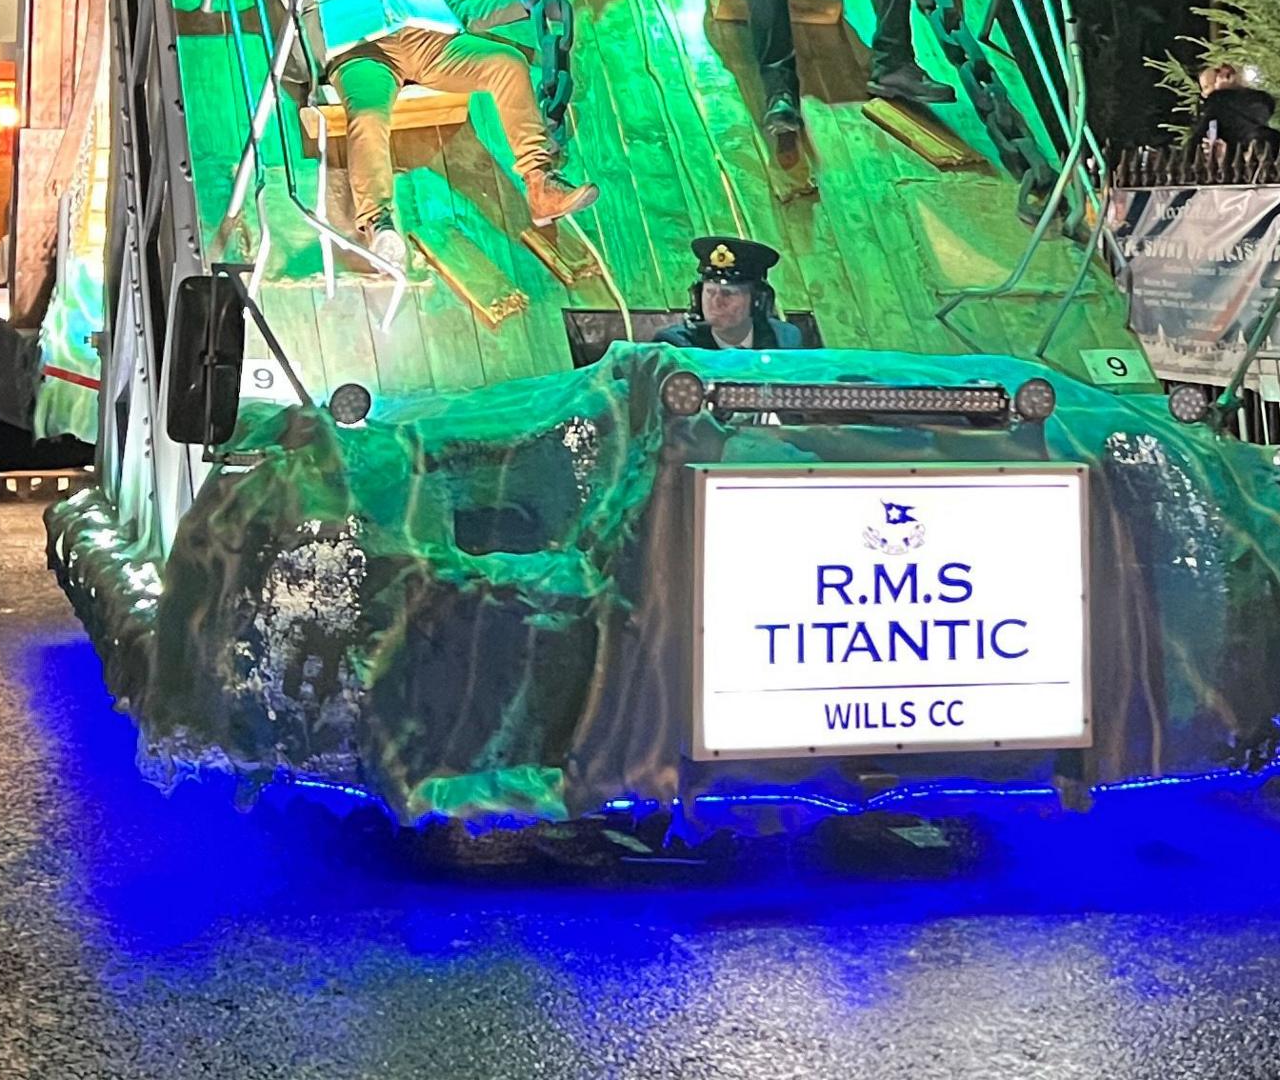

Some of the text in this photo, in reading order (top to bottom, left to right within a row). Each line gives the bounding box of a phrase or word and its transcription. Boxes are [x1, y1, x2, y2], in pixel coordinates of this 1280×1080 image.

[253, 368, 274, 389] 9
[1107, 356, 1128, 377] 9
[817, 563, 972, 605] R.M.S
[756, 619, 1028, 664] TITANTIC
[825, 700, 963, 729] WILLS CC
